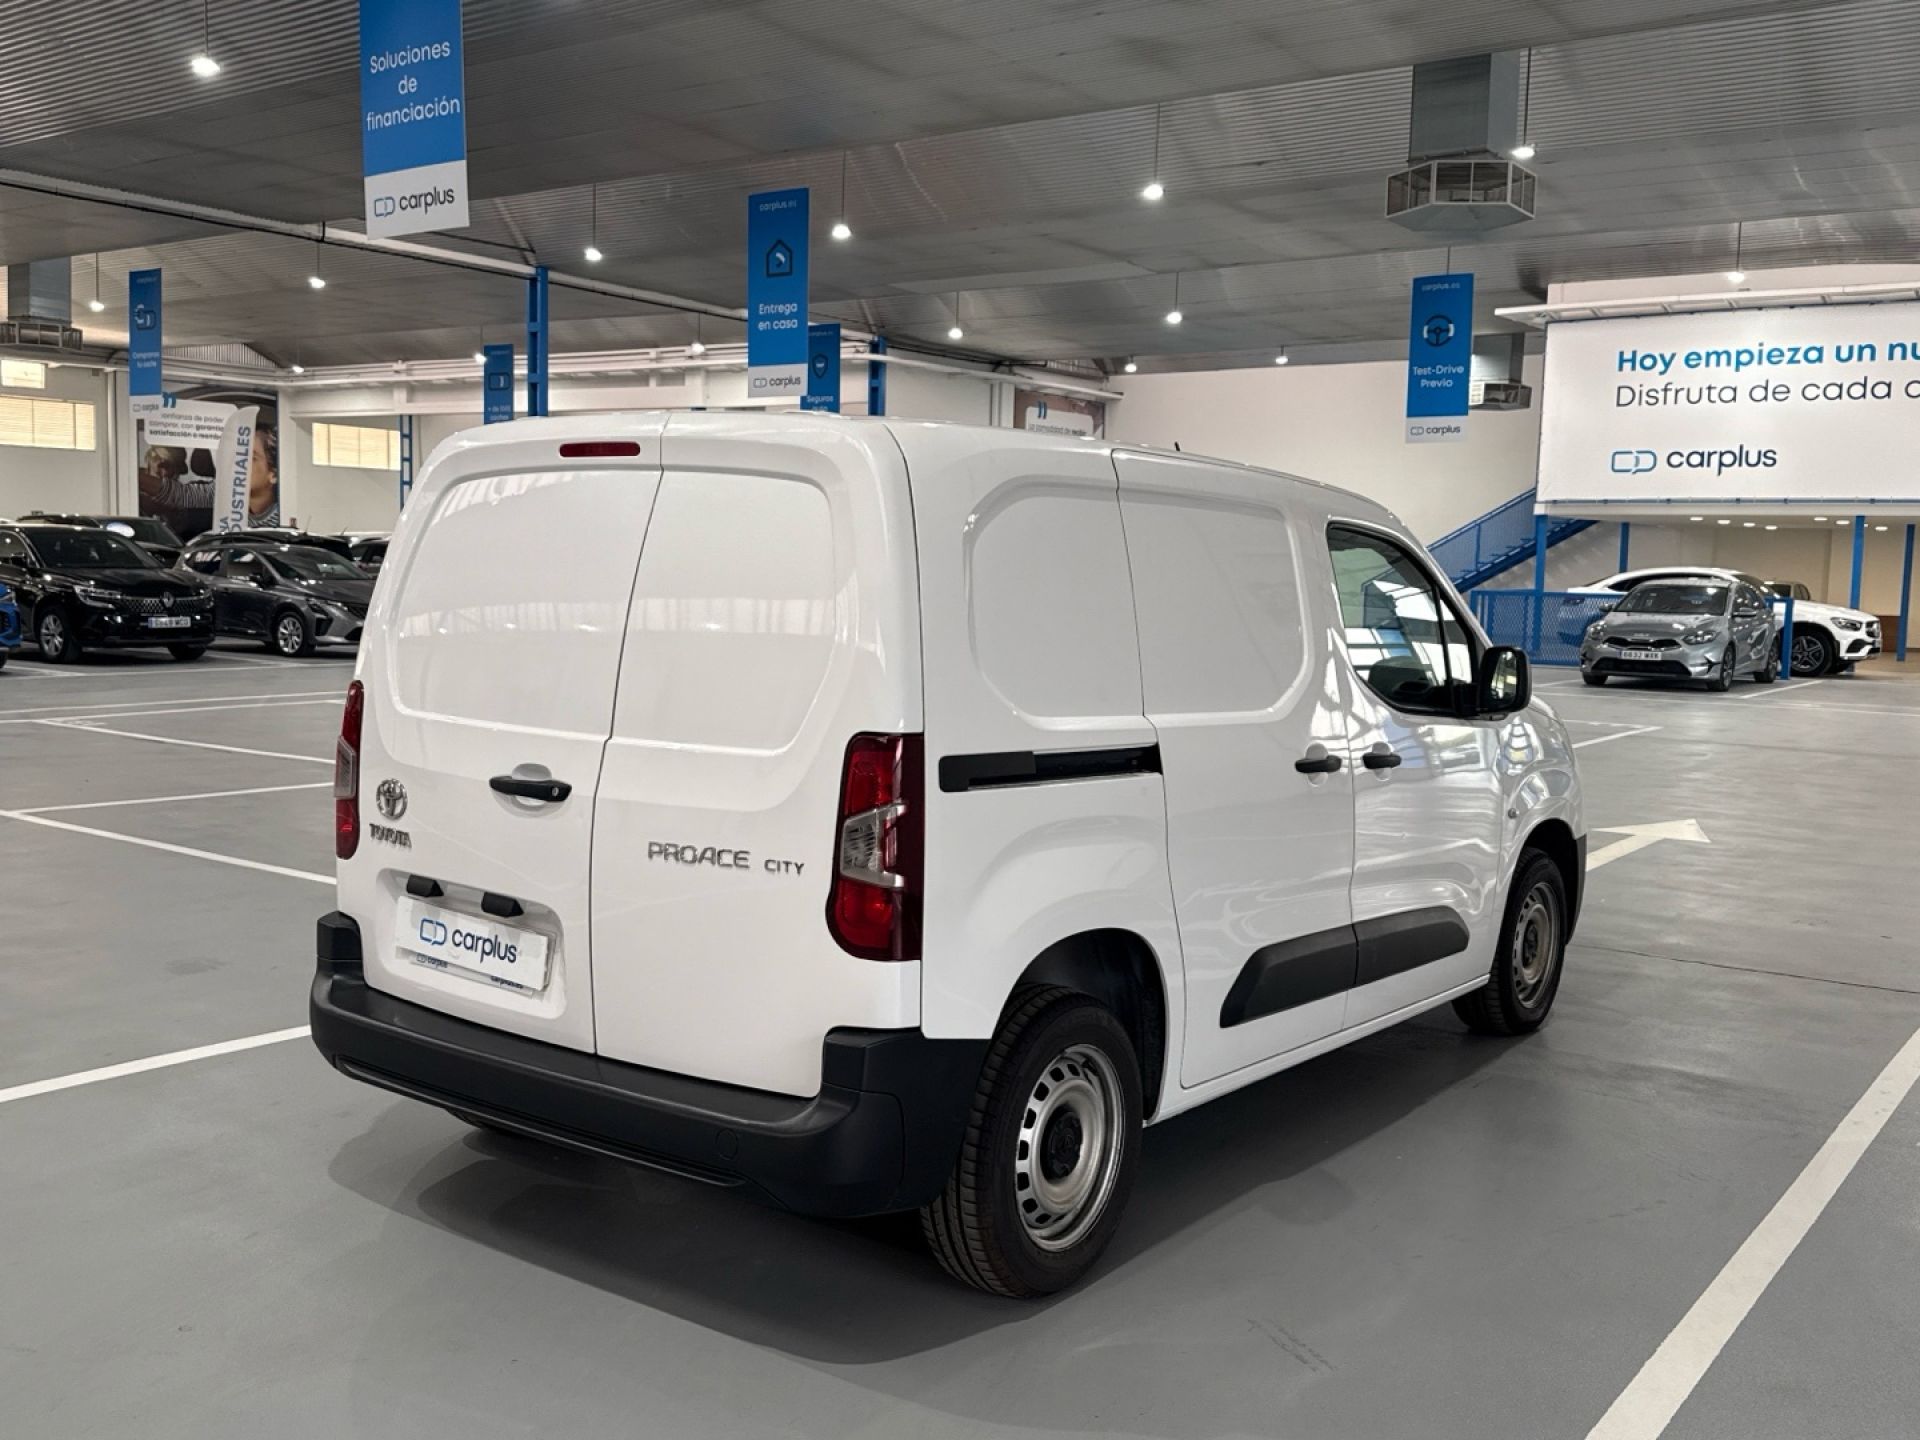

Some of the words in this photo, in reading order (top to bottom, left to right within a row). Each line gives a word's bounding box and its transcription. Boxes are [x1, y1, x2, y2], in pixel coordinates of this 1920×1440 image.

[370, 41, 451, 74] Soluciones
[398, 75, 418, 95] de
[366, 96, 461, 131] financiación
[399, 186, 455, 215] carplus
[758, 303, 798, 315] Entrega
[758, 321, 771, 331] en
[772, 319, 798, 330] casa
[1413, 364, 1465, 376] Test-Drive
[1617, 349, 1676, 375] Hoy
[1683, 342, 1824, 373] empieza
[1834, 343, 1877, 363] un
[1887, 341, 1920, 361] nu
[768, 375, 802, 389] carplus
[1420, 377, 1454, 388] Previo
[1615, 382, 1738, 407] Disfruta
[1748, 379, 1790, 402] de
[1800, 375, 1892, 401] cada
[1426, 424, 1461, 437] carplus
[1666, 444, 1778, 476] carplus
[369, 823, 412, 849] TOYOTA
[648, 841, 751, 869] PROACE
[764, 859, 804, 876] CITY
[452, 929, 517, 964] carplus
